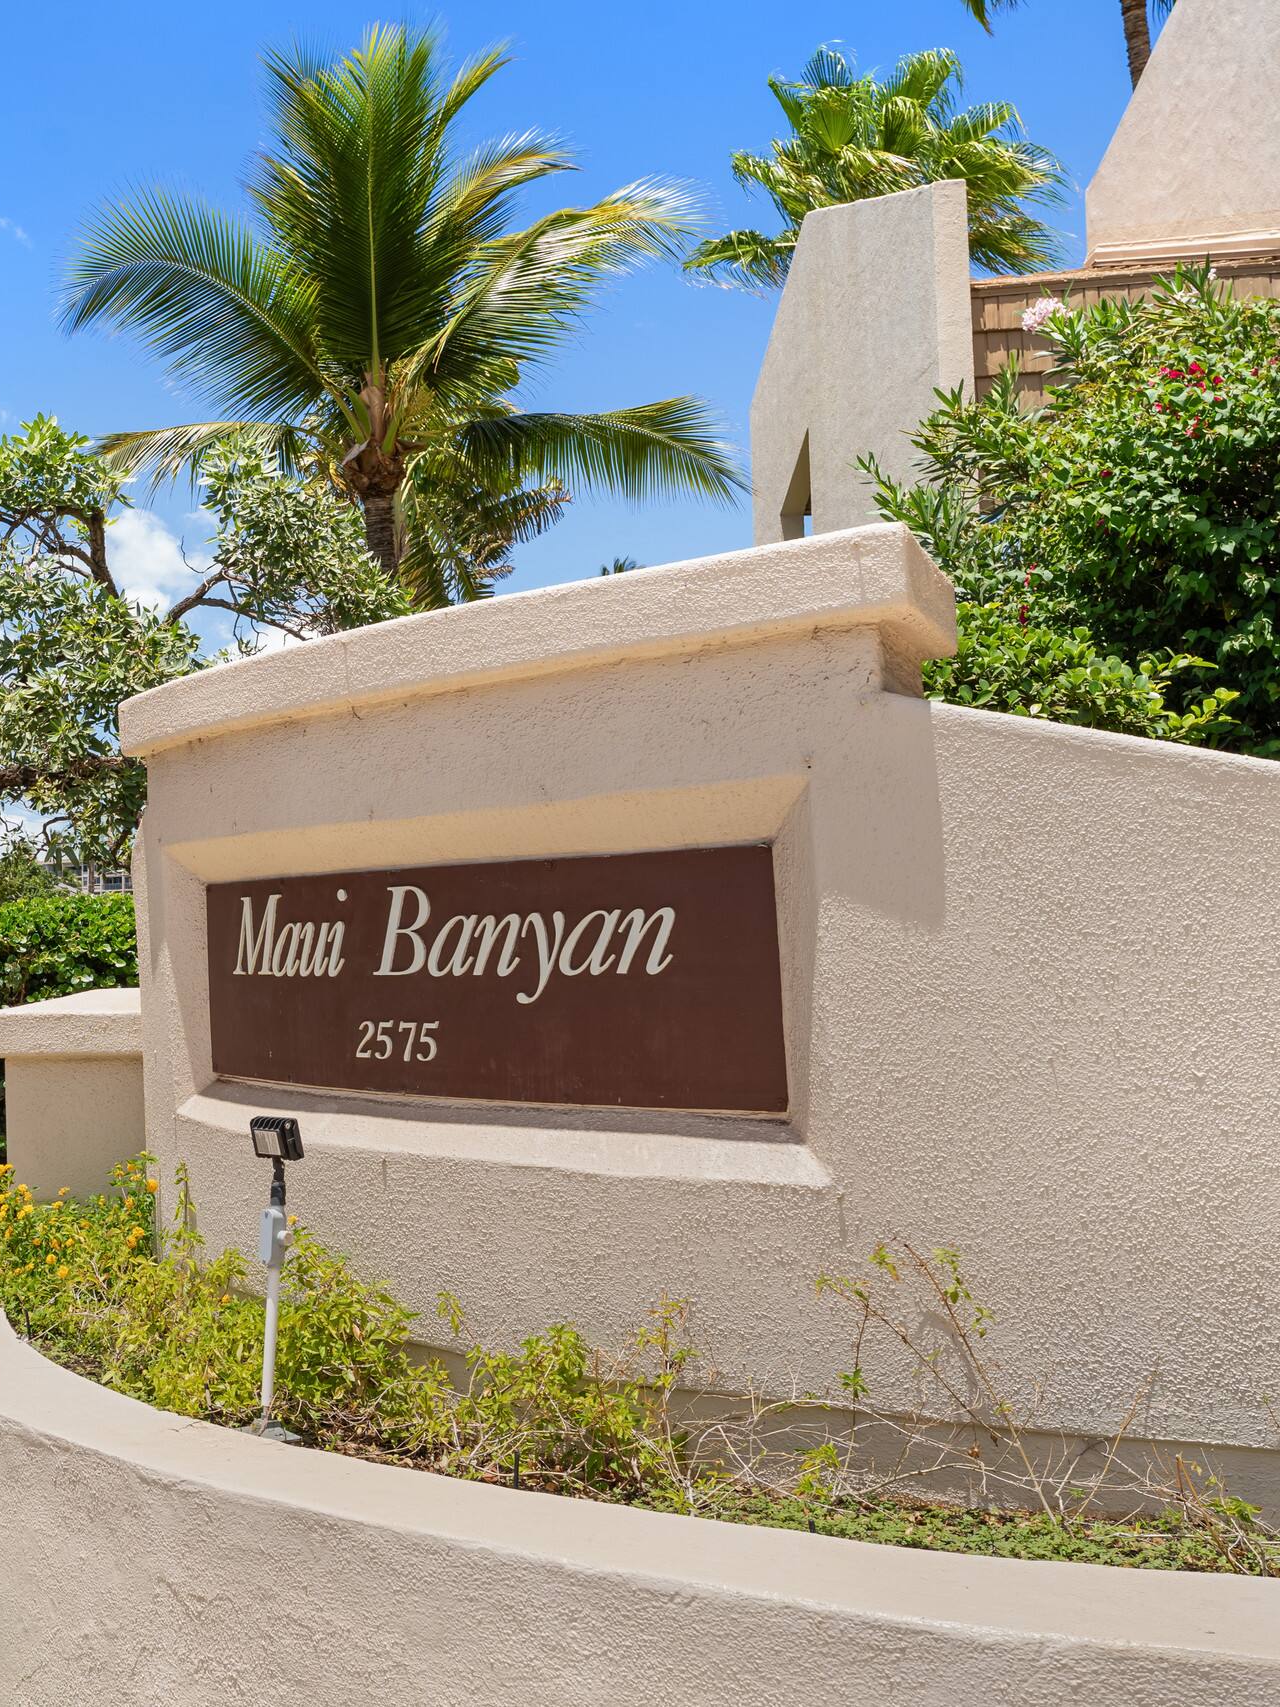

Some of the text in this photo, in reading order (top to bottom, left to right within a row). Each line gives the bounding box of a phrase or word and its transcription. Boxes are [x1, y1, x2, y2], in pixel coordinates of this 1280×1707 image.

[233, 886, 676, 1004] Maui Banyan
[355, 1020, 440, 1062] 2575
